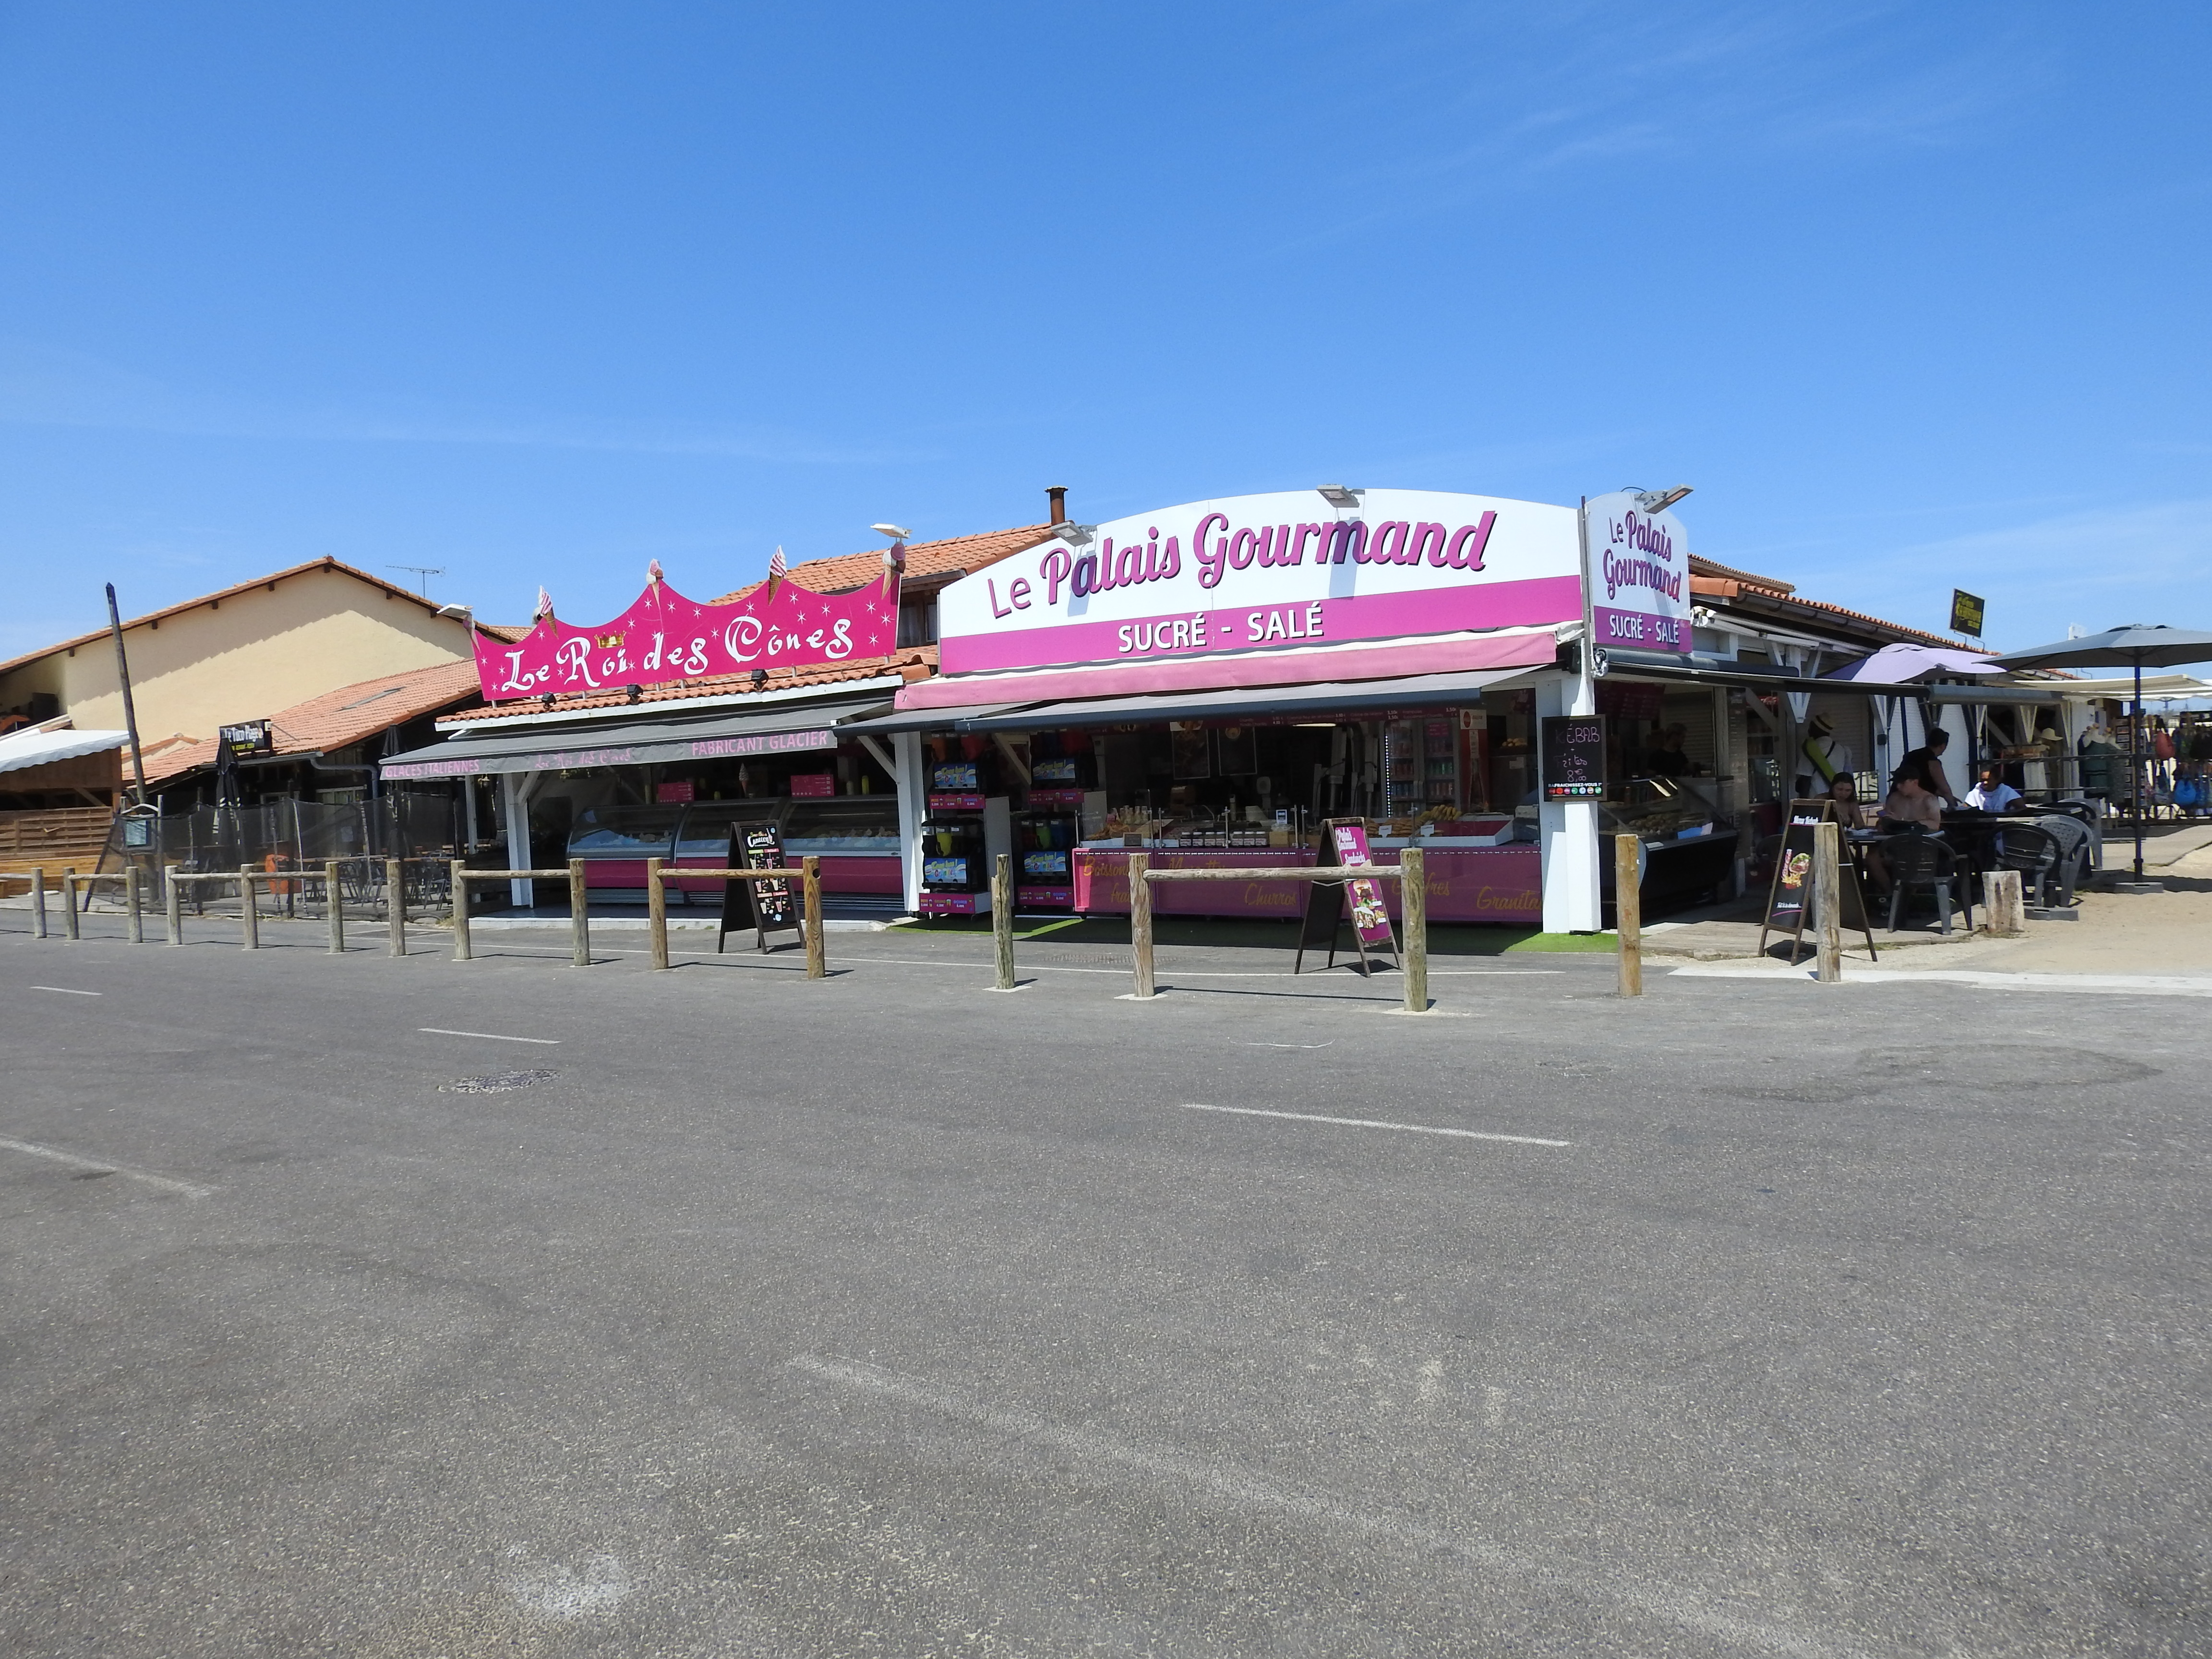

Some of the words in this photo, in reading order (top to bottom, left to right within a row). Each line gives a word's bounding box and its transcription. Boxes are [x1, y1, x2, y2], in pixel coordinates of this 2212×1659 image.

[1609, 517, 1623, 543] Le
[1625, 510, 1671, 562] Palais
[987, 577, 1031, 619] Le
[1039, 527, 1180, 605] Palais
[1193, 511, 1497, 589] Gourmand
[1603, 549, 1682, 602] Gourmand
[1118, 613, 1207, 653] SUCRÉ
[1248, 601, 1324, 641] SALÉ
[1609, 614, 1644, 640] SUCRÉ
[1656, 620, 1680, 644] SALÉ
[501, 649, 550, 691] Le
[556, 636, 628, 687] Roi
[643, 632, 709, 674] des
[724, 615, 853, 663] Cônes
[692, 736, 763, 756] FABRICANT
[769, 730, 827, 750] GLACIER
[385, 764, 422, 777] GLACES
[425, 759, 480, 774] ITALIENNES
[1245, 883, 1296, 906] Churros
[1391, 872, 1450, 896] Gfres
[1476, 886, 1542, 910] Granita
